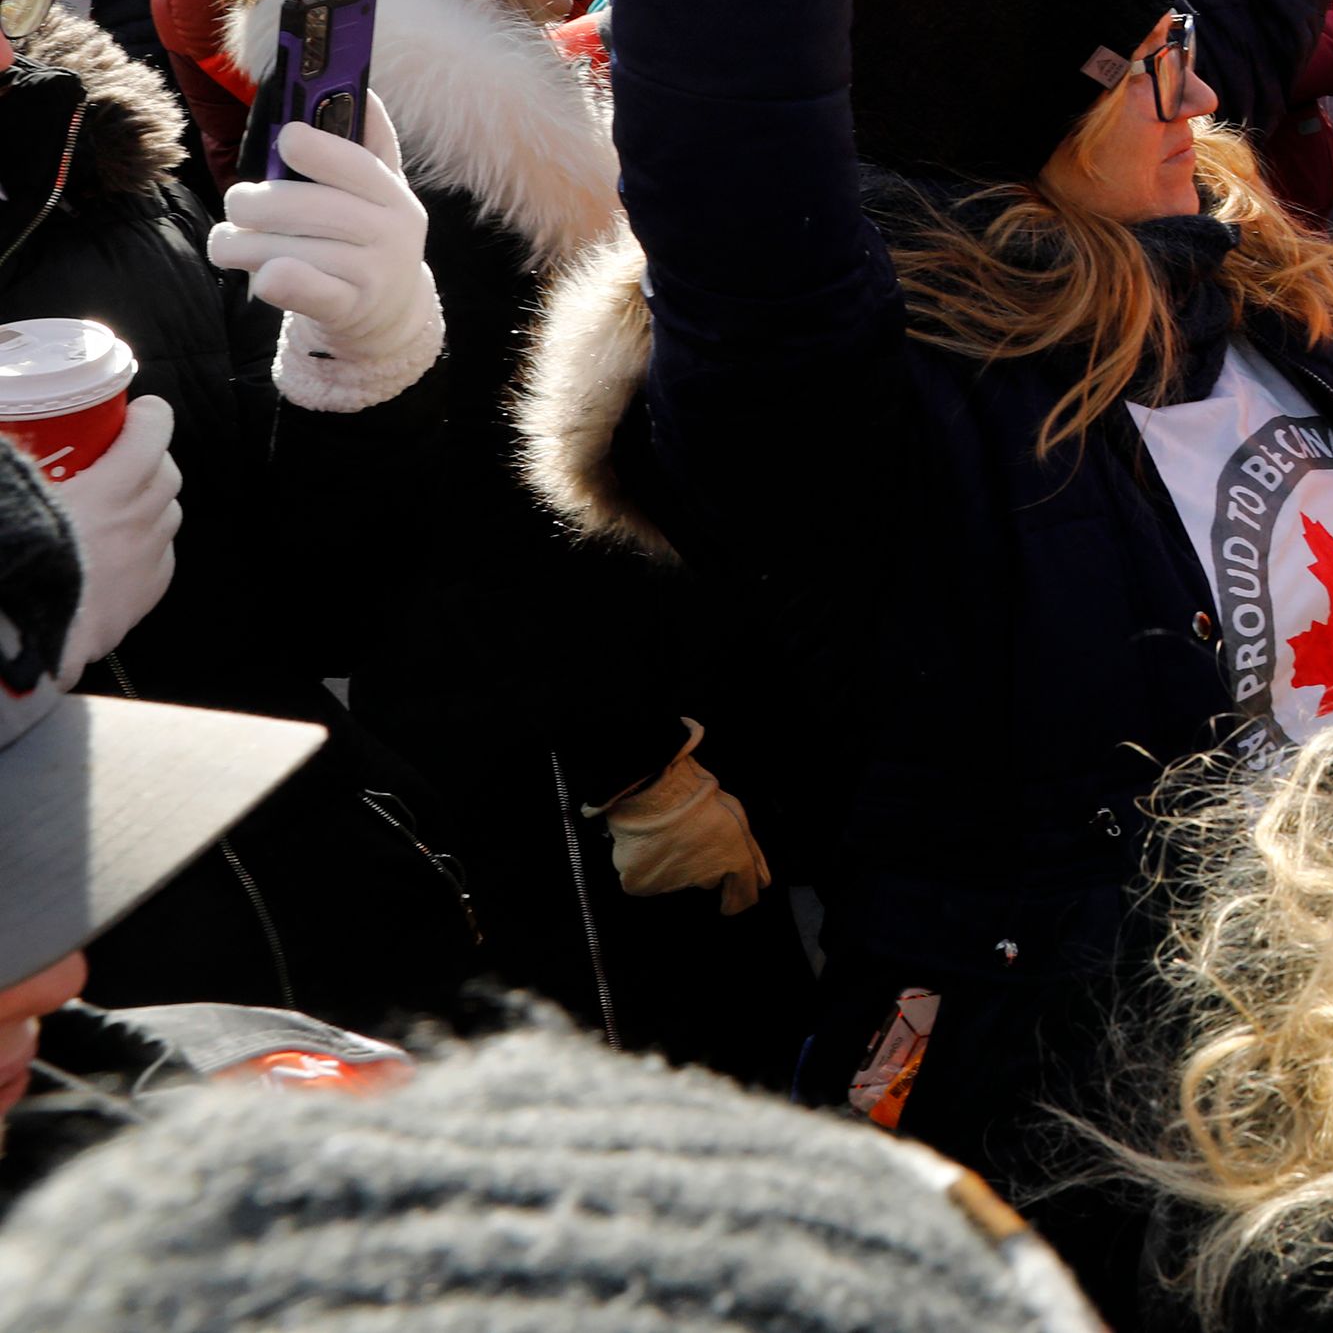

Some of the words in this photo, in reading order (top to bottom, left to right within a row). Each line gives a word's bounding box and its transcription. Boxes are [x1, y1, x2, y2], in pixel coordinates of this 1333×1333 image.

[1240, 443, 1295, 493] BE
[1226, 483, 1267, 531] TO
[1222, 535, 1267, 702] PROUD
